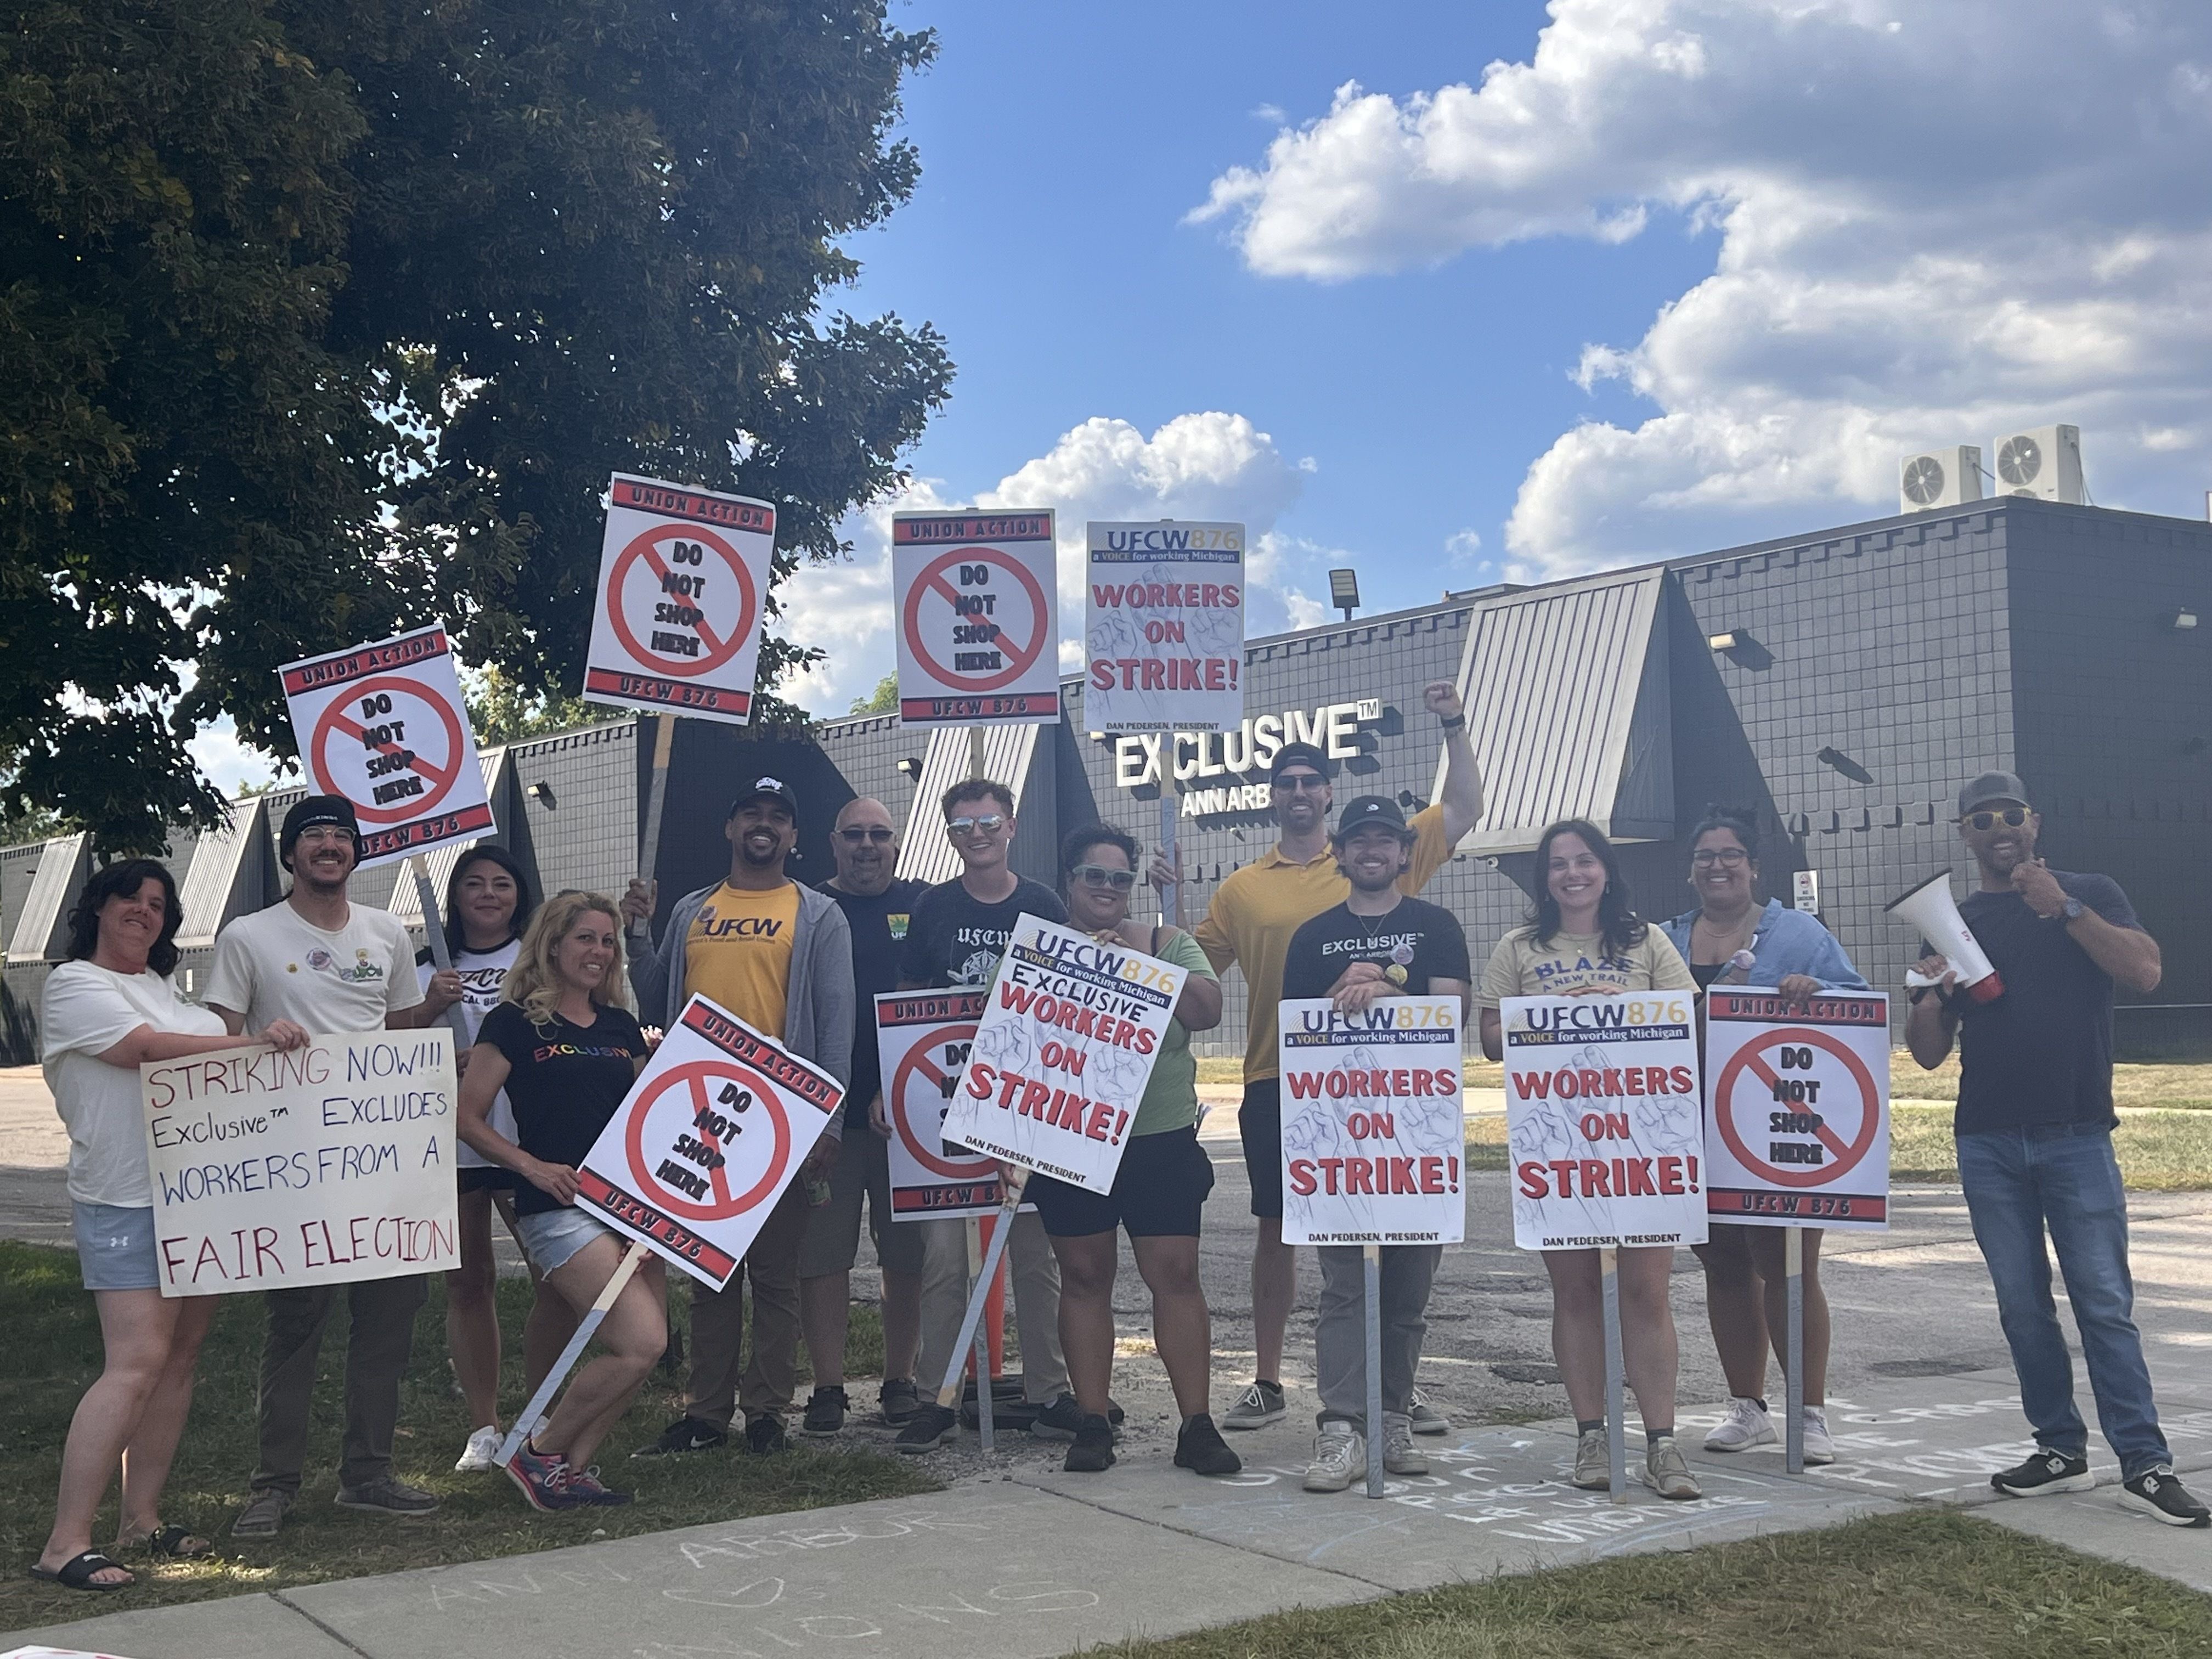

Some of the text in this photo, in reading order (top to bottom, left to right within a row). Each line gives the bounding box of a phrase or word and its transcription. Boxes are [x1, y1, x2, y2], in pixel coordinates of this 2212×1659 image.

[632, 488, 765, 526] UNION ACTION
[910, 520, 1041, 539] UNION ACTION
[673, 541, 702, 566] DO
[1092, 550, 1235, 563] a VOICE for working Michigan
[662, 572, 706, 599] NOT
[960, 566, 989, 586] DO
[955, 595, 996, 616] NOT
[1092, 584, 1240, 608] WORKERS
[655, 603, 703, 627] SHOP
[651, 631, 701, 657] HERE
[953, 624, 1001, 644] SHOP
[1145, 620, 1184, 644] ON
[301, 636, 437, 685] UNION ACTION
[955, 651, 1001, 671] HERE
[1090, 658, 1238, 691] STRIKE!
[361, 693, 392, 719] DO
[620, 678, 719, 707] UFCW 876
[933, 698, 1028, 716] UFCW 876
[362, 721, 405, 751] NOT
[366, 751, 415, 779] SHOP
[373, 776, 424, 805] HERE
[1181, 783, 1272, 817] ANN ARB
[362, 817, 459, 856] UFCW 876
[704, 918, 783, 936] UFCW
[1013, 950, 1166, 1005] a VOICE for working Michigan
[1534, 957, 1632, 980] BLAZE
[1012, 966, 1148, 1022] EXCLUSIVE
[1543, 973, 1629, 993] A NEW TRAIL
[895, 1000, 949, 1019] UNION
[1000, 980, 1157, 1054] WORKERS
[1729, 999, 1876, 1019] UNION ACTION
[1296, 1034, 1328, 1045] VOICE
[1331, 1032, 1347, 1043] for
[1350, 1031, 1396, 1045] working
[1398, 1031, 1449, 1043] Michigan
[1520, 1032, 1555, 1043] VOICE
[1558, 1030, 1576, 1042] for
[1578, 1029, 1628, 1043] working
[1630, 1027, 1684, 1042] Michigan
[703, 1015, 831, 1103] UNION ACTION
[1041, 1042, 1087, 1077] ON
[1780, 1047, 1813, 1070] DO
[149, 1041, 441, 1109] STRIKING NOW!!!
[1287, 1069, 1457, 1099] WORKERS
[1512, 1066, 1693, 1101] WORKERS
[718, 1082, 752, 1114] DO
[966, 1063, 1129, 1146] STRIKE!
[1773, 1080, 1820, 1103] NOT
[323, 1092, 448, 1128] EXCLUDES
[693, 1106, 742, 1146] NOT
[1347, 1113, 1395, 1139] ON
[1581, 1114, 1630, 1142] ON
[1769, 1113, 1824, 1135] SHOP
[673, 1133, 725, 1172] SHOP
[965, 1135, 985, 1150] DAN
[1037, 1160, 1086, 1183] PRESIDENT
[1769, 1143, 1824, 1165] HERE
[160, 1136, 440, 1207] WORKERS FROM A
[656, 1158, 710, 1201] HERE
[1289, 1156, 1459, 1195] STRIKE!
[1518, 1156, 1699, 1199] STRIKE!
[922, 1188, 974, 1206] UFCW
[1742, 1194, 1850, 1215] UFCW 876
[604, 1190, 703, 1260] UFCW 876
[1308, 1233, 1328, 1241] DAN
[1385, 1232, 1439, 1240] PRESIDENT
[161, 1217, 455, 1285] FAIR ELECTION
[1543, 1237, 1564, 1246] DAN
[1625, 1233, 1681, 1243] PRESIDENT
